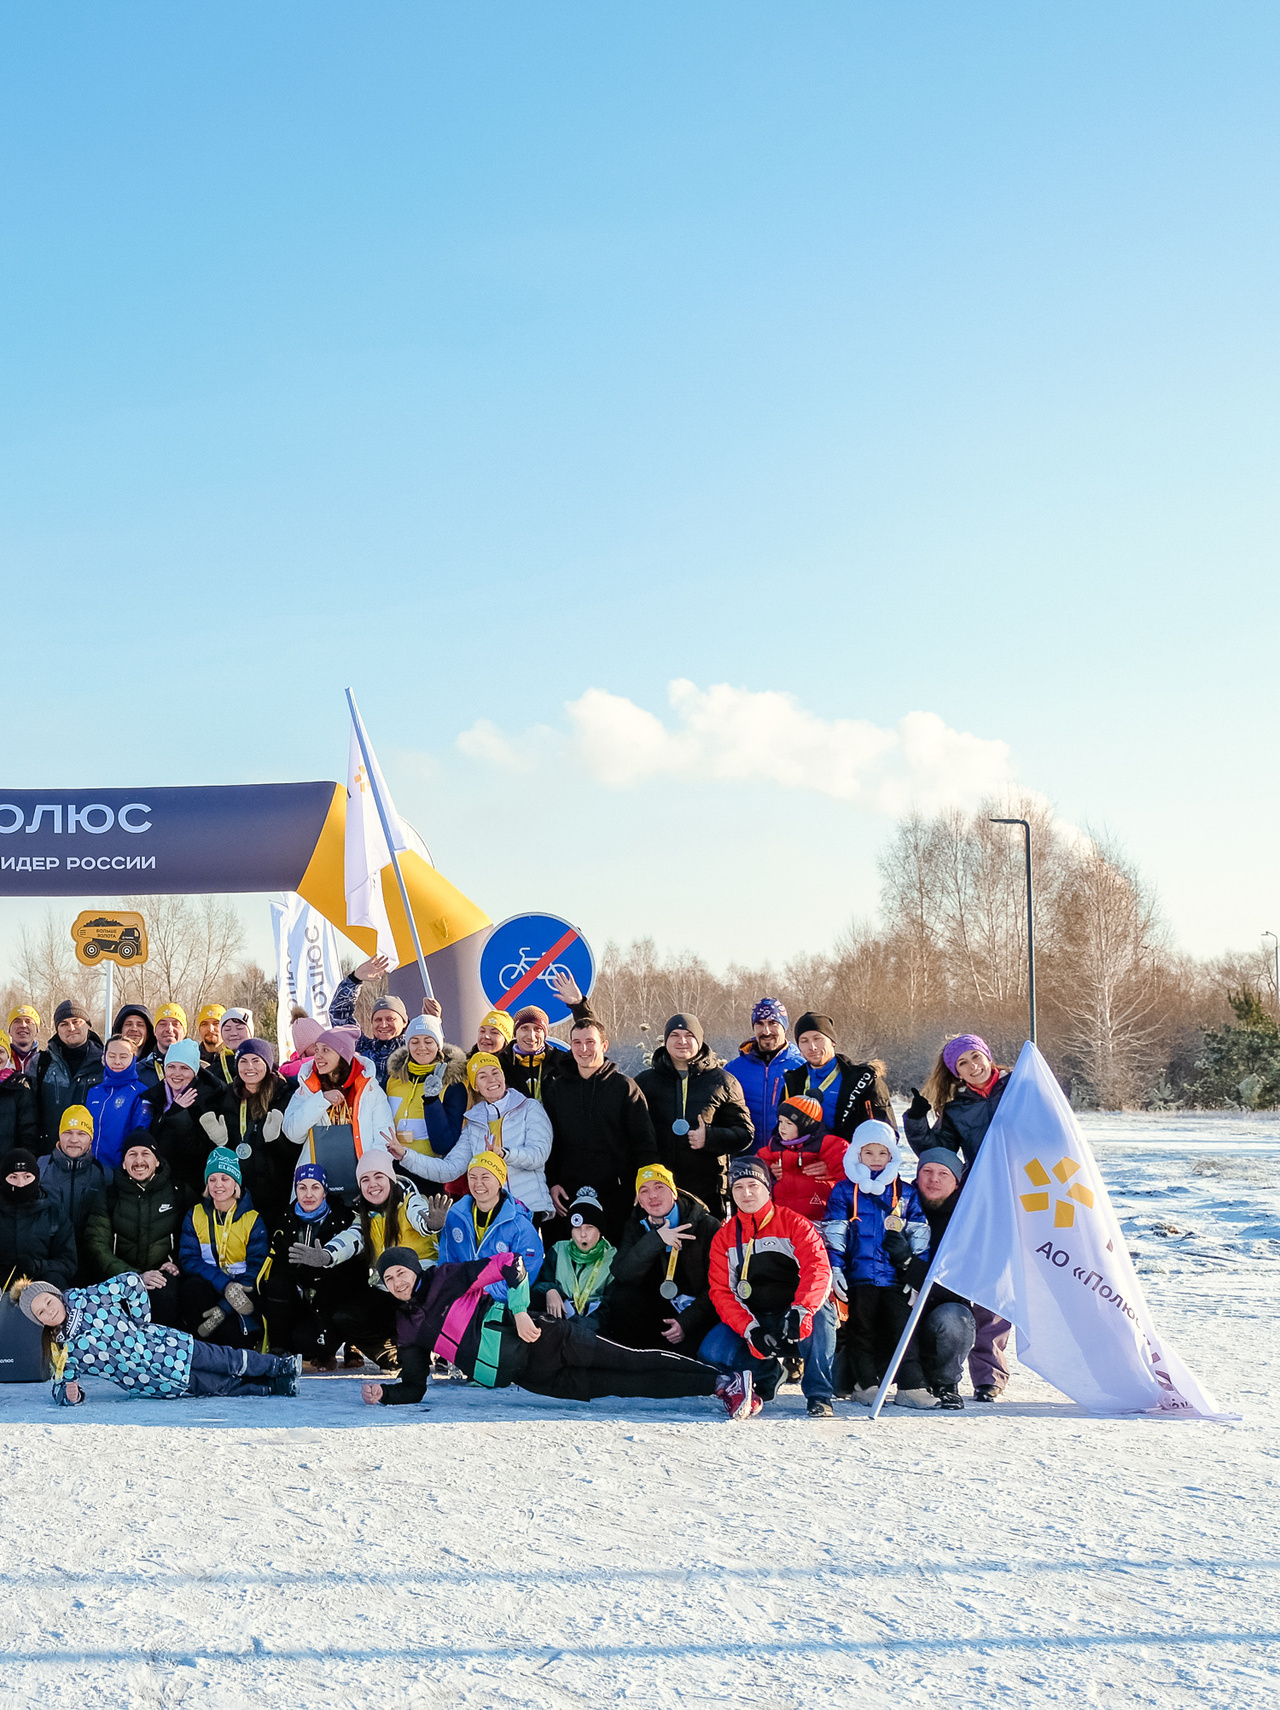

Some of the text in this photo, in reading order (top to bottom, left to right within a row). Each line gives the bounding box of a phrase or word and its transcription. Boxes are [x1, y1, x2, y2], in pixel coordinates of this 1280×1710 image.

[66, 855, 156, 871] РОССИИ
[480, 1158, 505, 1179] ПОЛЮС
[1035, 1241, 1071, 1268] АО
